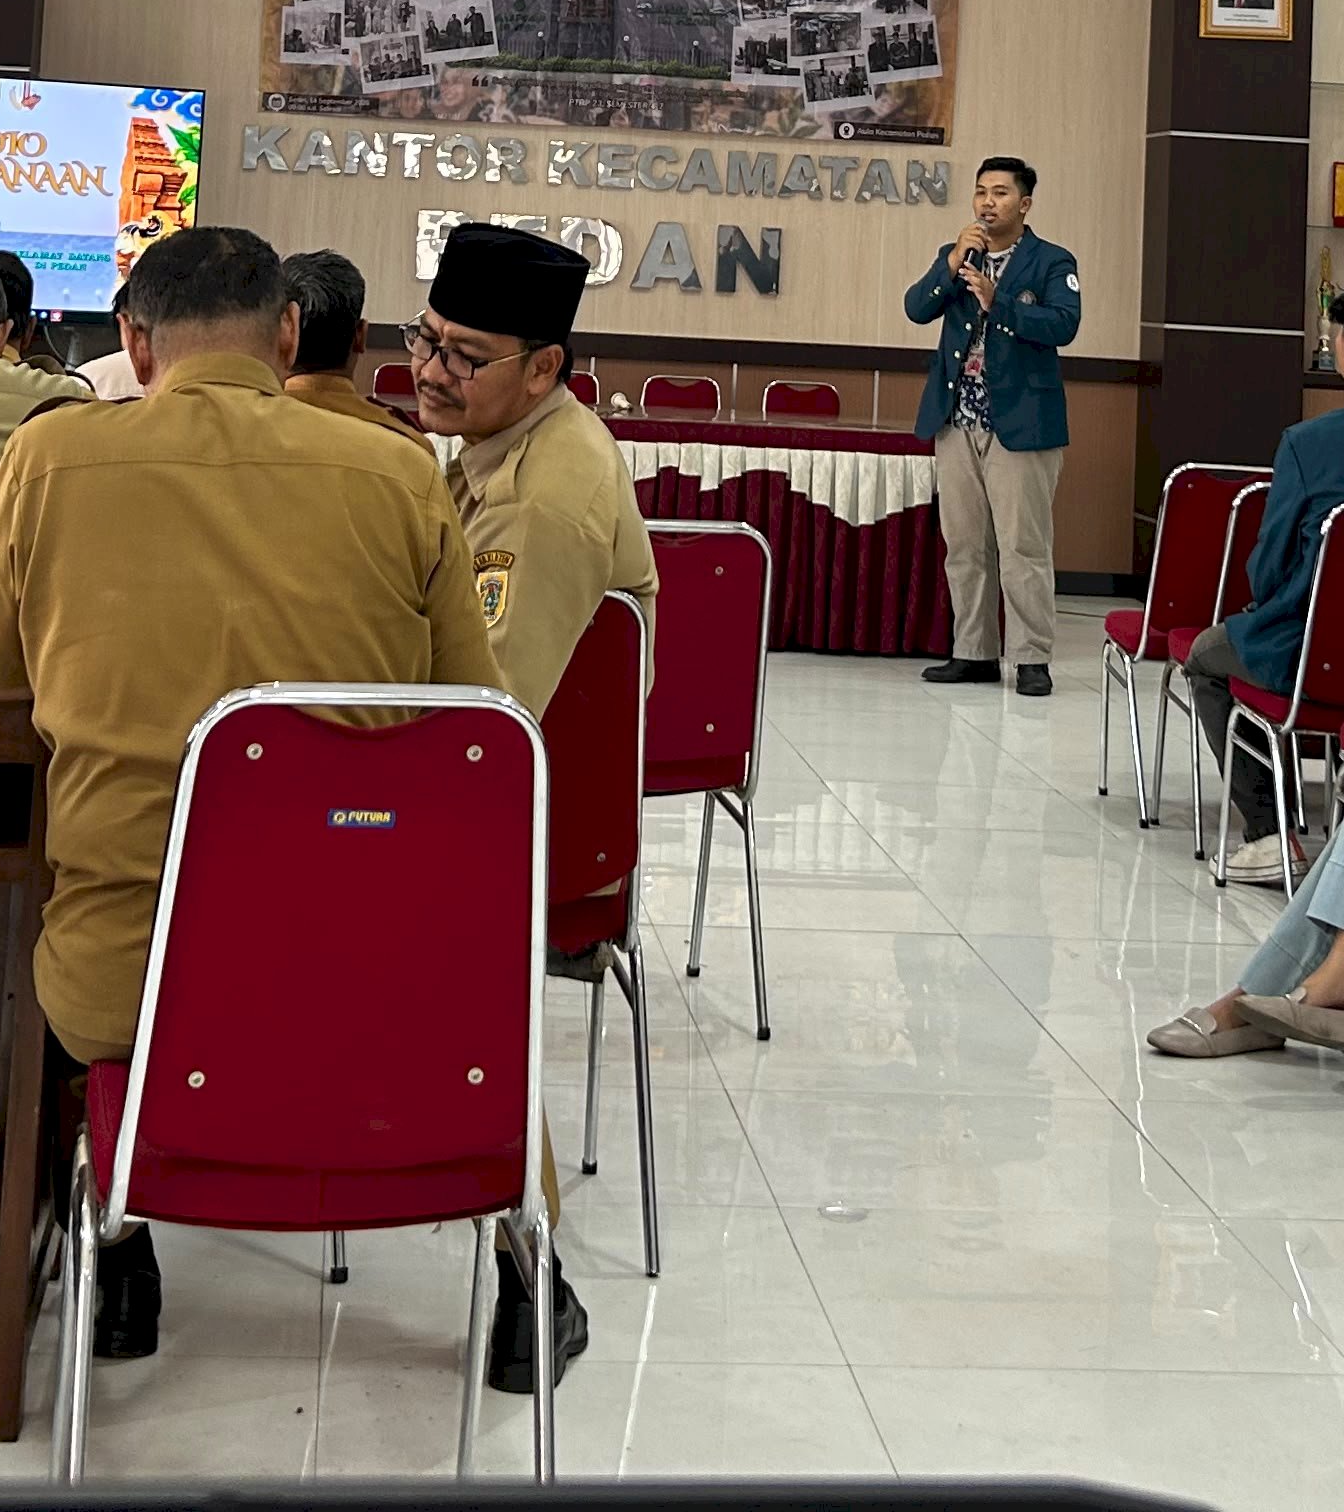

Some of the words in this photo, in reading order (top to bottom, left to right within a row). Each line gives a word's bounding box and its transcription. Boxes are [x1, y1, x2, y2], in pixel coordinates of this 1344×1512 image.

[242, 125, 529, 184] KANTOR
[546, 139, 951, 206] KECAMATAN
[415, 209, 783, 296] PDAN
[348, 810, 391, 823] FUTURA
